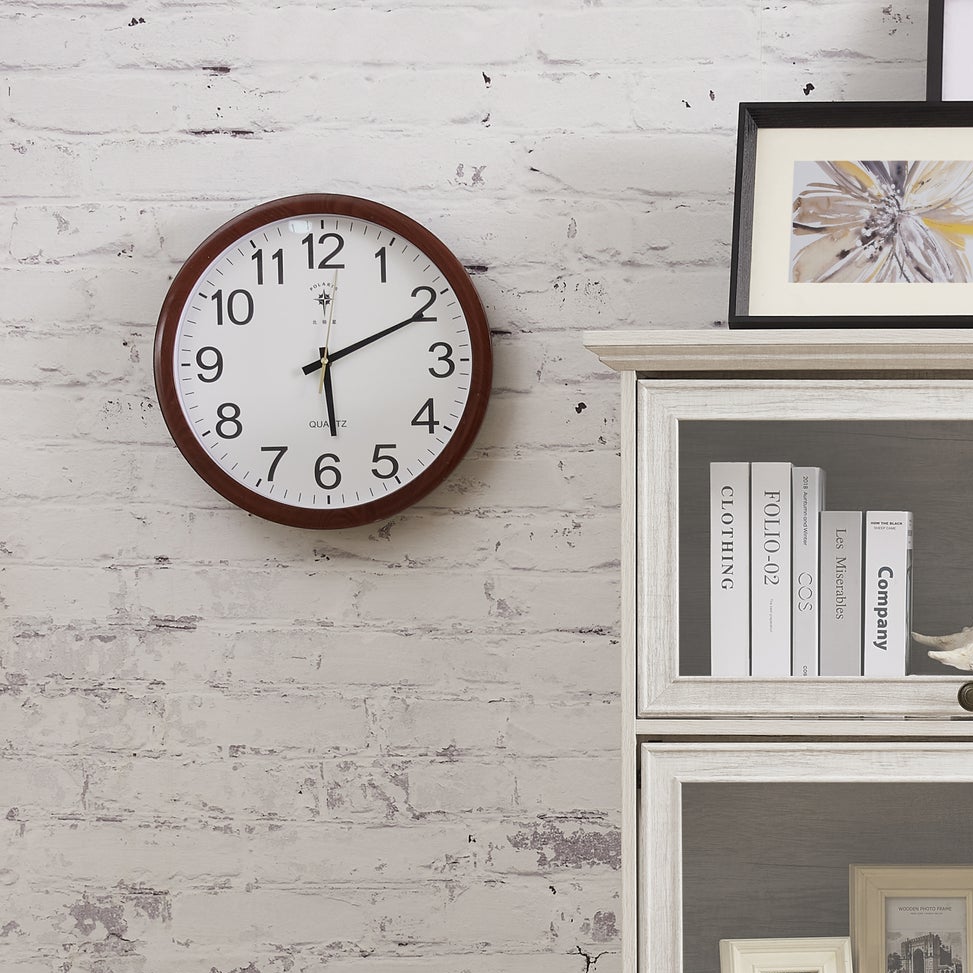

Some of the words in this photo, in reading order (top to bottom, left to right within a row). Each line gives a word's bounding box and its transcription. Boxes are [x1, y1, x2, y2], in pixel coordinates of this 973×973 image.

[251, 248, 284, 285] 11
[302, 233, 345, 269] 12
[375, 247, 386, 284] 1
[211, 289, 254, 326] 10
[410, 286, 437, 322] 2
[196, 346, 224, 382] 9
[428, 342, 456, 378] 3
[215, 403, 243, 439] 8
[309, 420, 347, 428] QUATZ
[411, 398, 440, 434] 4
[260, 446, 288, 482] 7
[314, 454, 342, 490] 6
[371, 444, 400, 479] 5
[721, 486, 734, 590] CLOTHING
[764, 490, 780, 586] FOLIO-02
[836, 528, 846, 550] Les
[798, 572, 812, 612] COS
[836, 557, 846, 620] Miserables
[873, 566, 894, 651] Company
